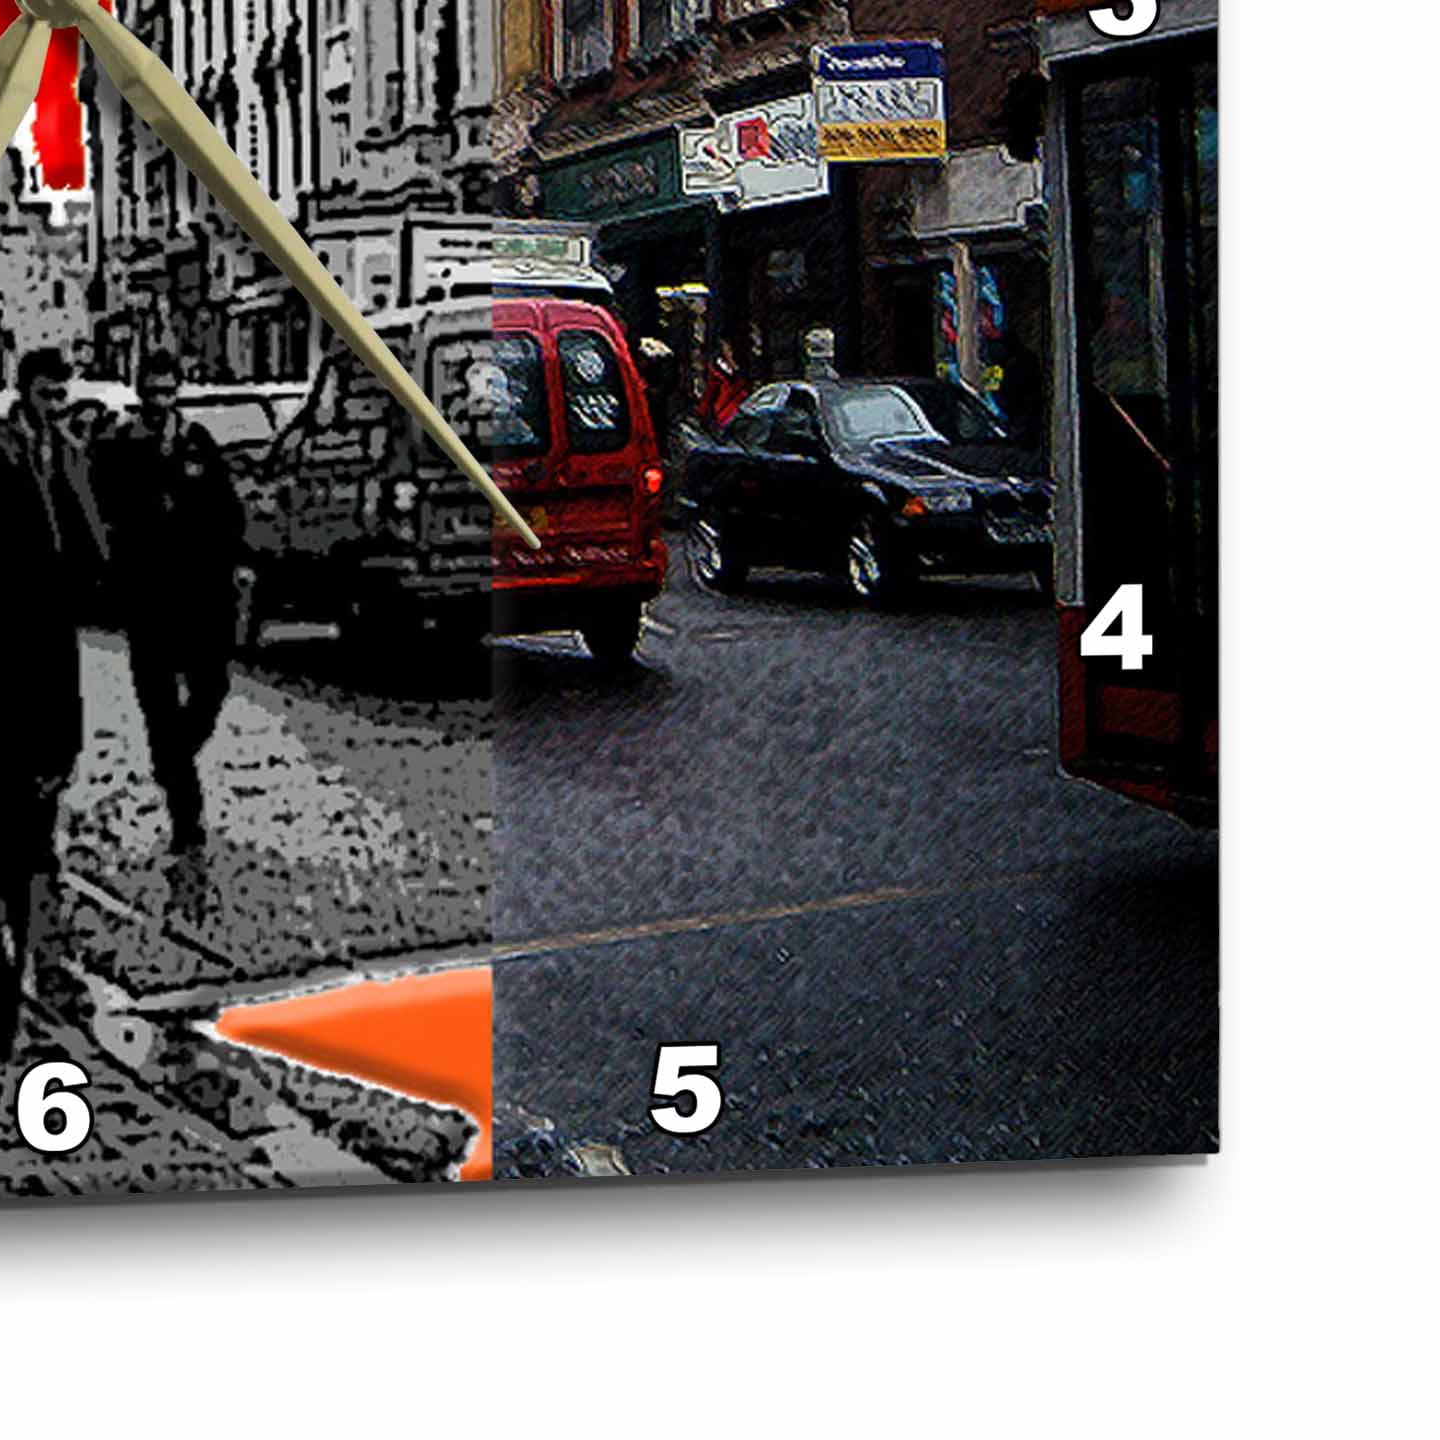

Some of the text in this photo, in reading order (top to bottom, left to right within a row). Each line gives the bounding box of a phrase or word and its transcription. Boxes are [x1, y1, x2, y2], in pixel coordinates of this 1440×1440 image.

[1078, 582, 1155, 672] 4
[16, 1060, 93, 1154] 6
[649, 1043, 723, 1136] 5
